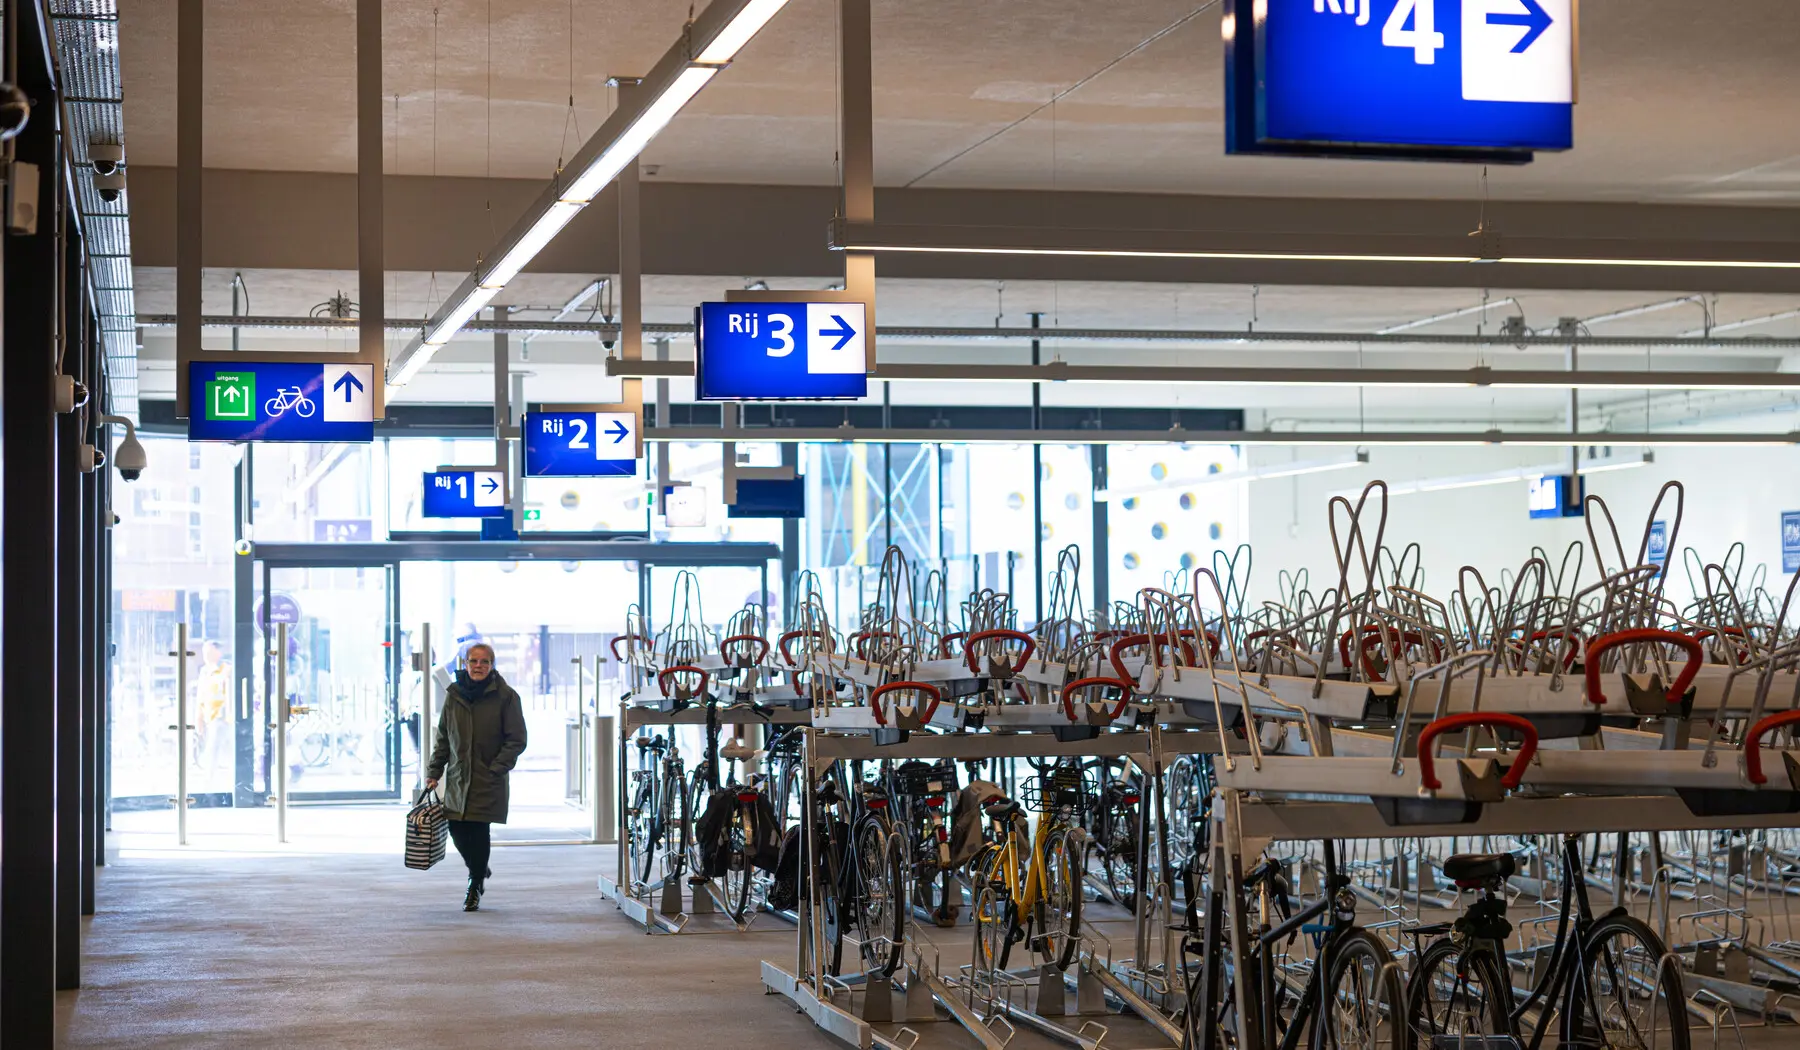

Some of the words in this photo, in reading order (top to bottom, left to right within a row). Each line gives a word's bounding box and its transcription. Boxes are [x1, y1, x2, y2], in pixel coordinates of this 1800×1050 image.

[1382, 0, 1444, 65] 4
[728, 312, 759, 339] Rij
[766, 313, 795, 358] 3
[216, 374, 239, 382] uitgang
[542, 418, 564, 437] Rij
[569, 418, 590, 449] 2
[434, 476, 452, 489] Rij
[455, 476, 468, 499] 1
